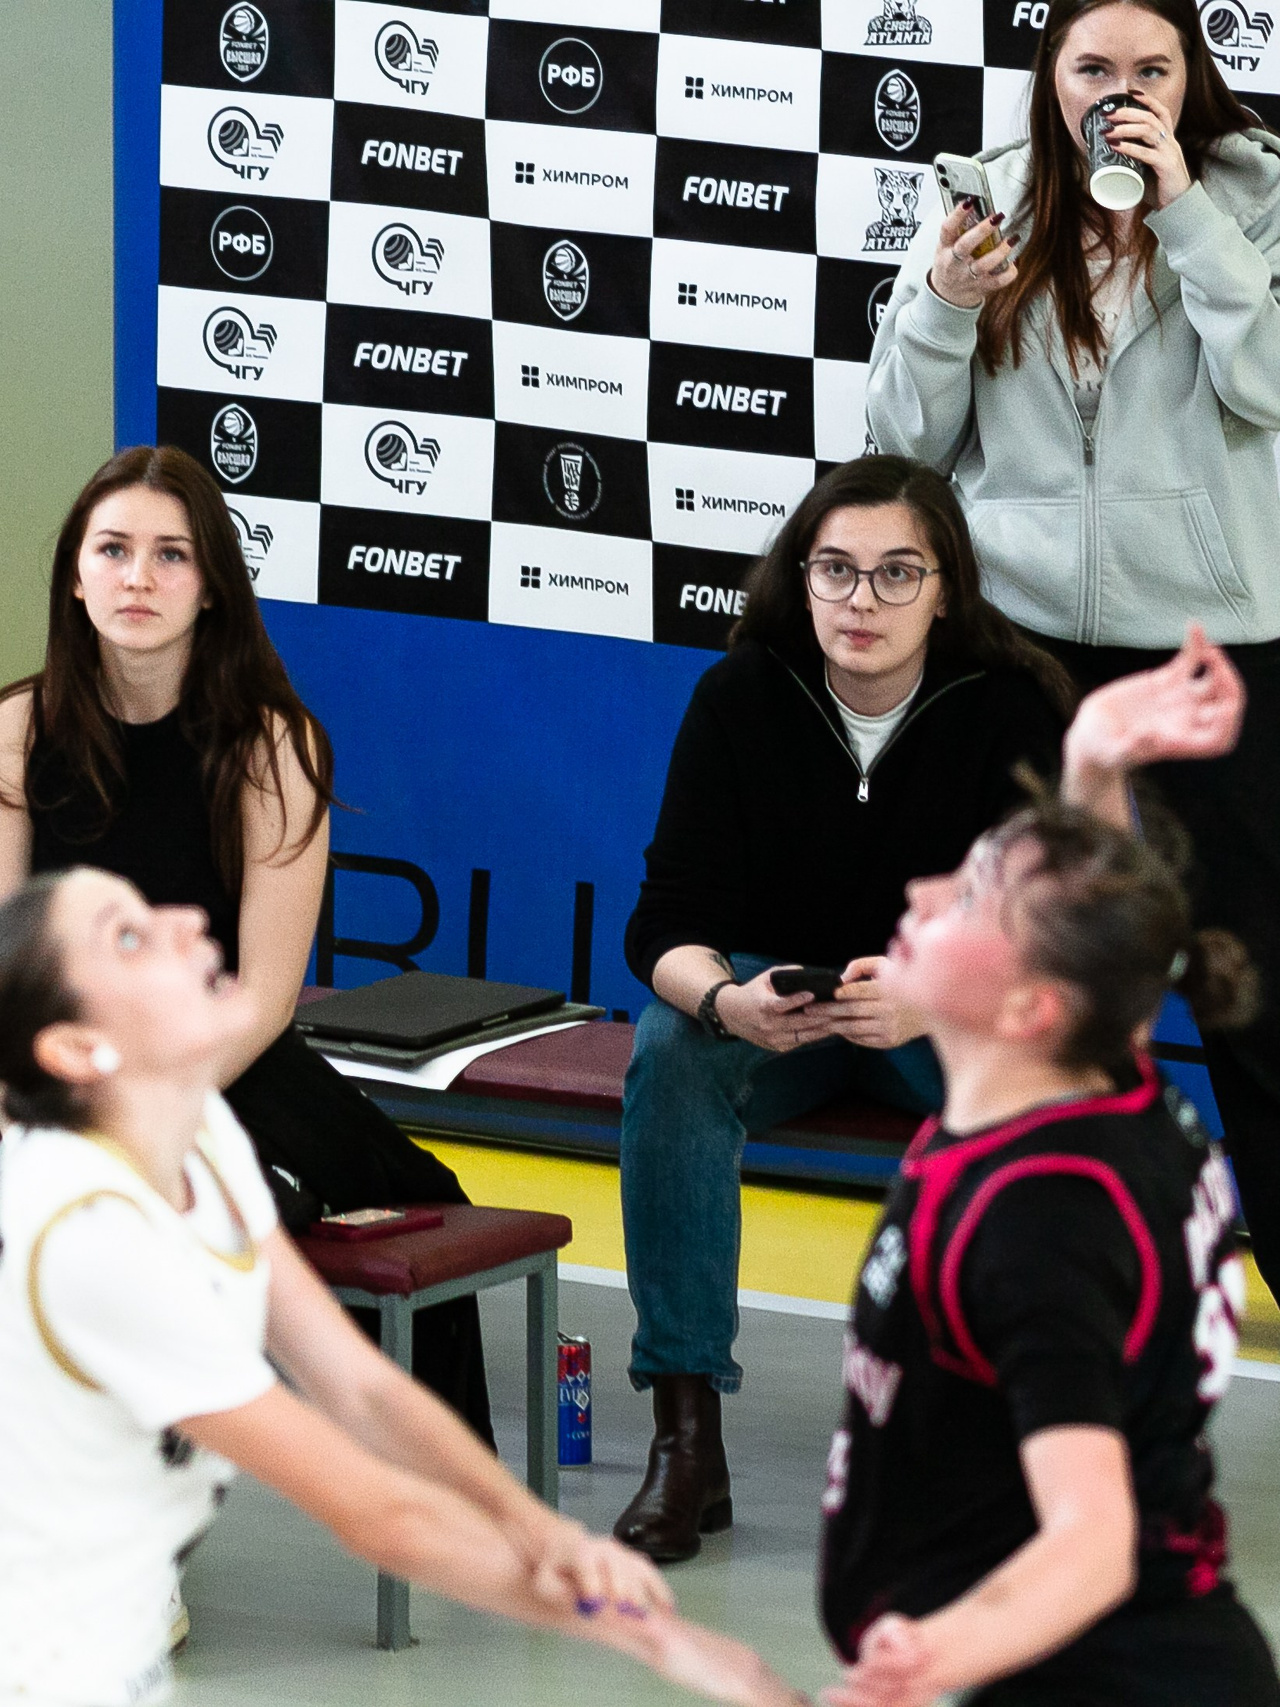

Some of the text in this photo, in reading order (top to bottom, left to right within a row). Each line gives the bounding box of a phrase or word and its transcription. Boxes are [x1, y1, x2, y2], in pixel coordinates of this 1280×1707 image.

[866, 31, 930, 44] ATLANTA
[1221, 54, 1261, 72] ЧГУ
[398, 79, 430, 96] ЧГУ
[547, 64, 596, 89] РФБ
[711, 83, 793, 105] ХИМПРОМ
[361, 139, 464, 176] FONBET
[231, 164, 270, 181] ЧГУ
[542, 168, 629, 189] ХИМПРОМ
[682, 175, 790, 212] FONBET
[218, 231, 266, 256] РФБ
[398, 279, 433, 296] ЧГУ
[704, 290, 787, 312] ХИМПРОМ
[353, 342, 468, 377] FONBET
[227, 364, 264, 381] ЧГУ
[546, 372, 623, 396] ХИМПРОМ
[676, 380, 787, 416] FONBET
[390, 479, 427, 496] ЧГУ
[701, 495, 786, 518] ХИМПРОМ
[347, 545, 462, 581] FONBET
[548, 572, 629, 596] ХИМПРОМ
